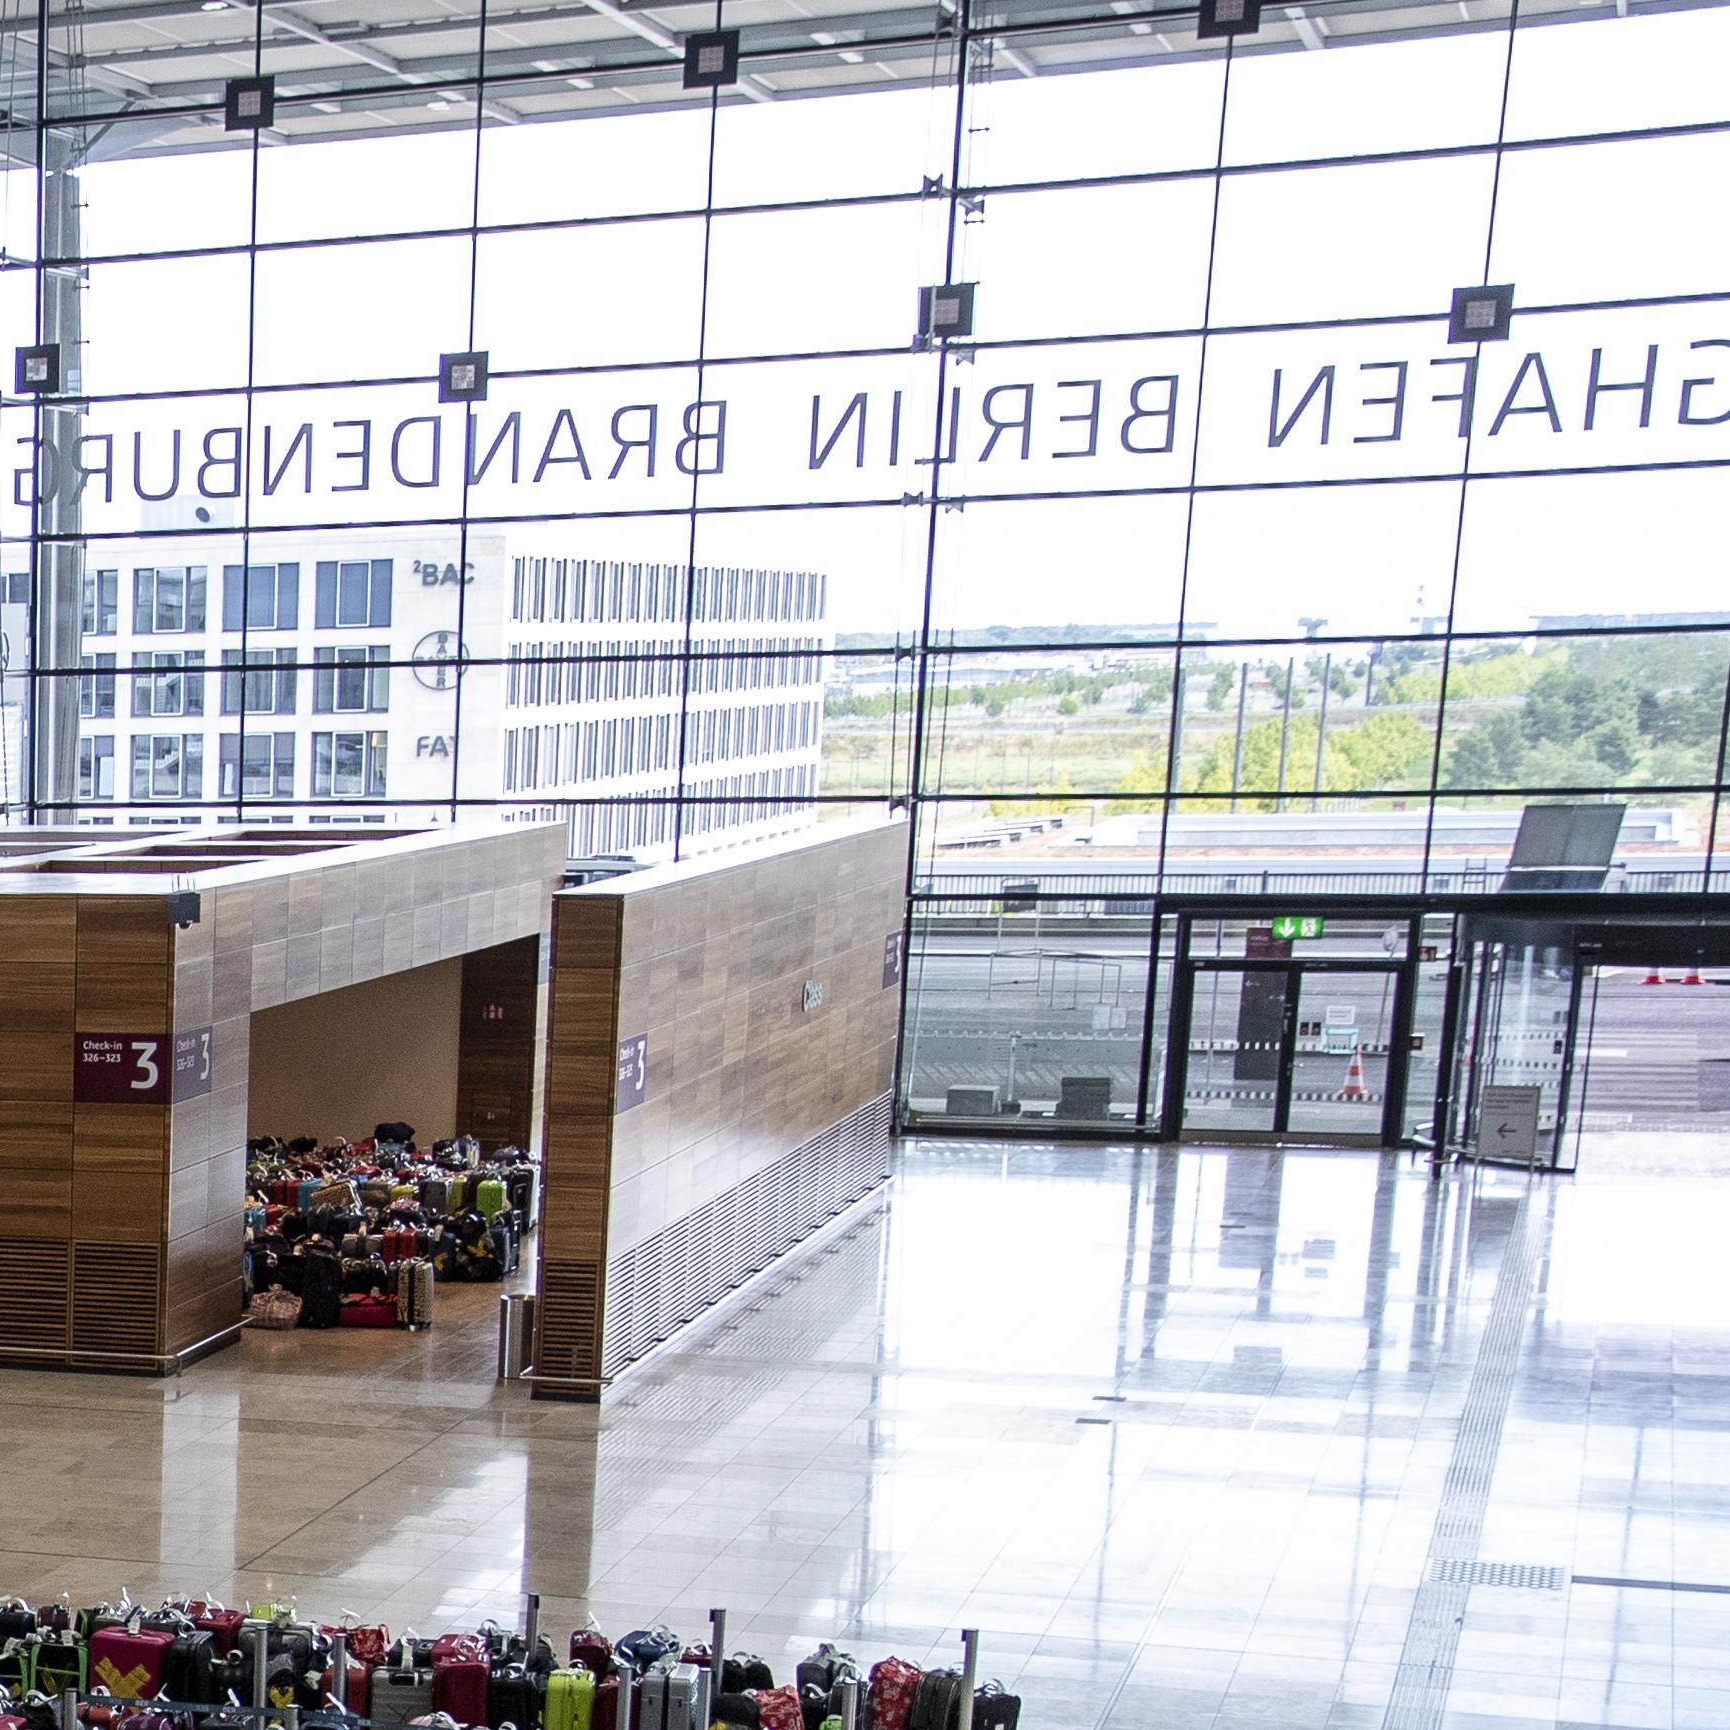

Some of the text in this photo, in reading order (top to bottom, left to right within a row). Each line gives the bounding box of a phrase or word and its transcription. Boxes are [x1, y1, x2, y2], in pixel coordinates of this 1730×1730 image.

[437, 633, 449, 688] BAER
[82, 1039, 123, 1051] Check-in
[130, 1042, 160, 1090] 3
[199, 1032, 211, 1081] 3
[635, 1040, 646, 1091] 3
